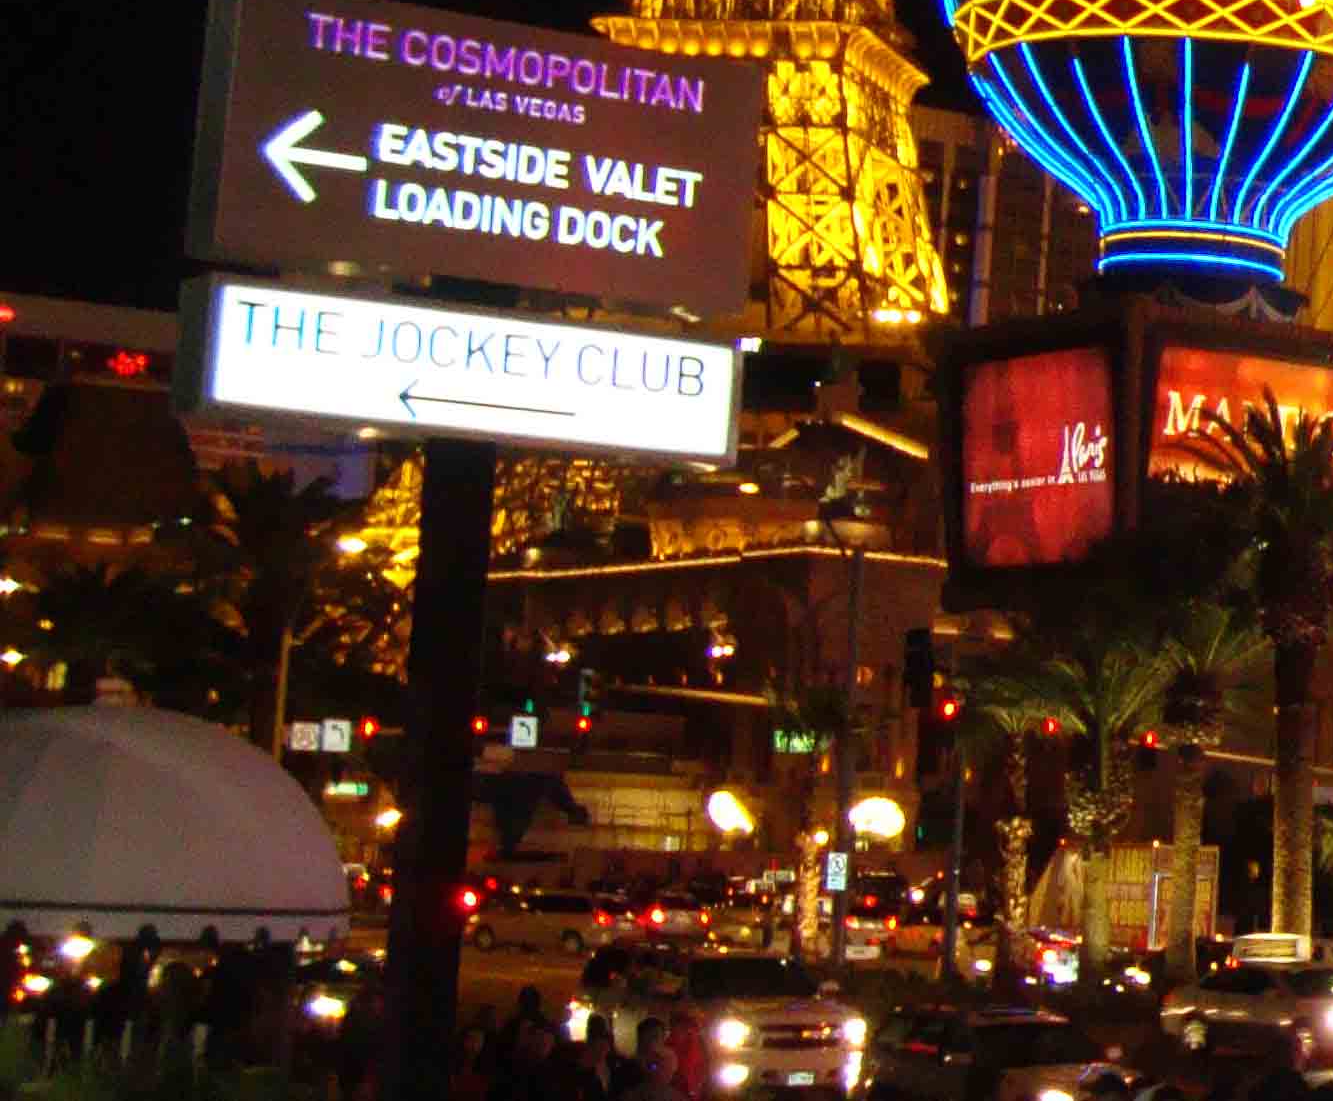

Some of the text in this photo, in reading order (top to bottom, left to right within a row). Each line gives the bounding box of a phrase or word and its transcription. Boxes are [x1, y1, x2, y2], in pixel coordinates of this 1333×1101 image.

[307, 12, 705, 114] THE COSMOPOLITAN
[466, 88, 508, 113] LAS
[515, 93, 586, 125] VEGAS
[373, 122, 703, 209] EASTSIDE VALET
[371, 178, 664, 259] LOADING DOCK
[239, 300, 706, 398] THE JOCKEY CLUB
[1071, 422, 1108, 473] Paris
